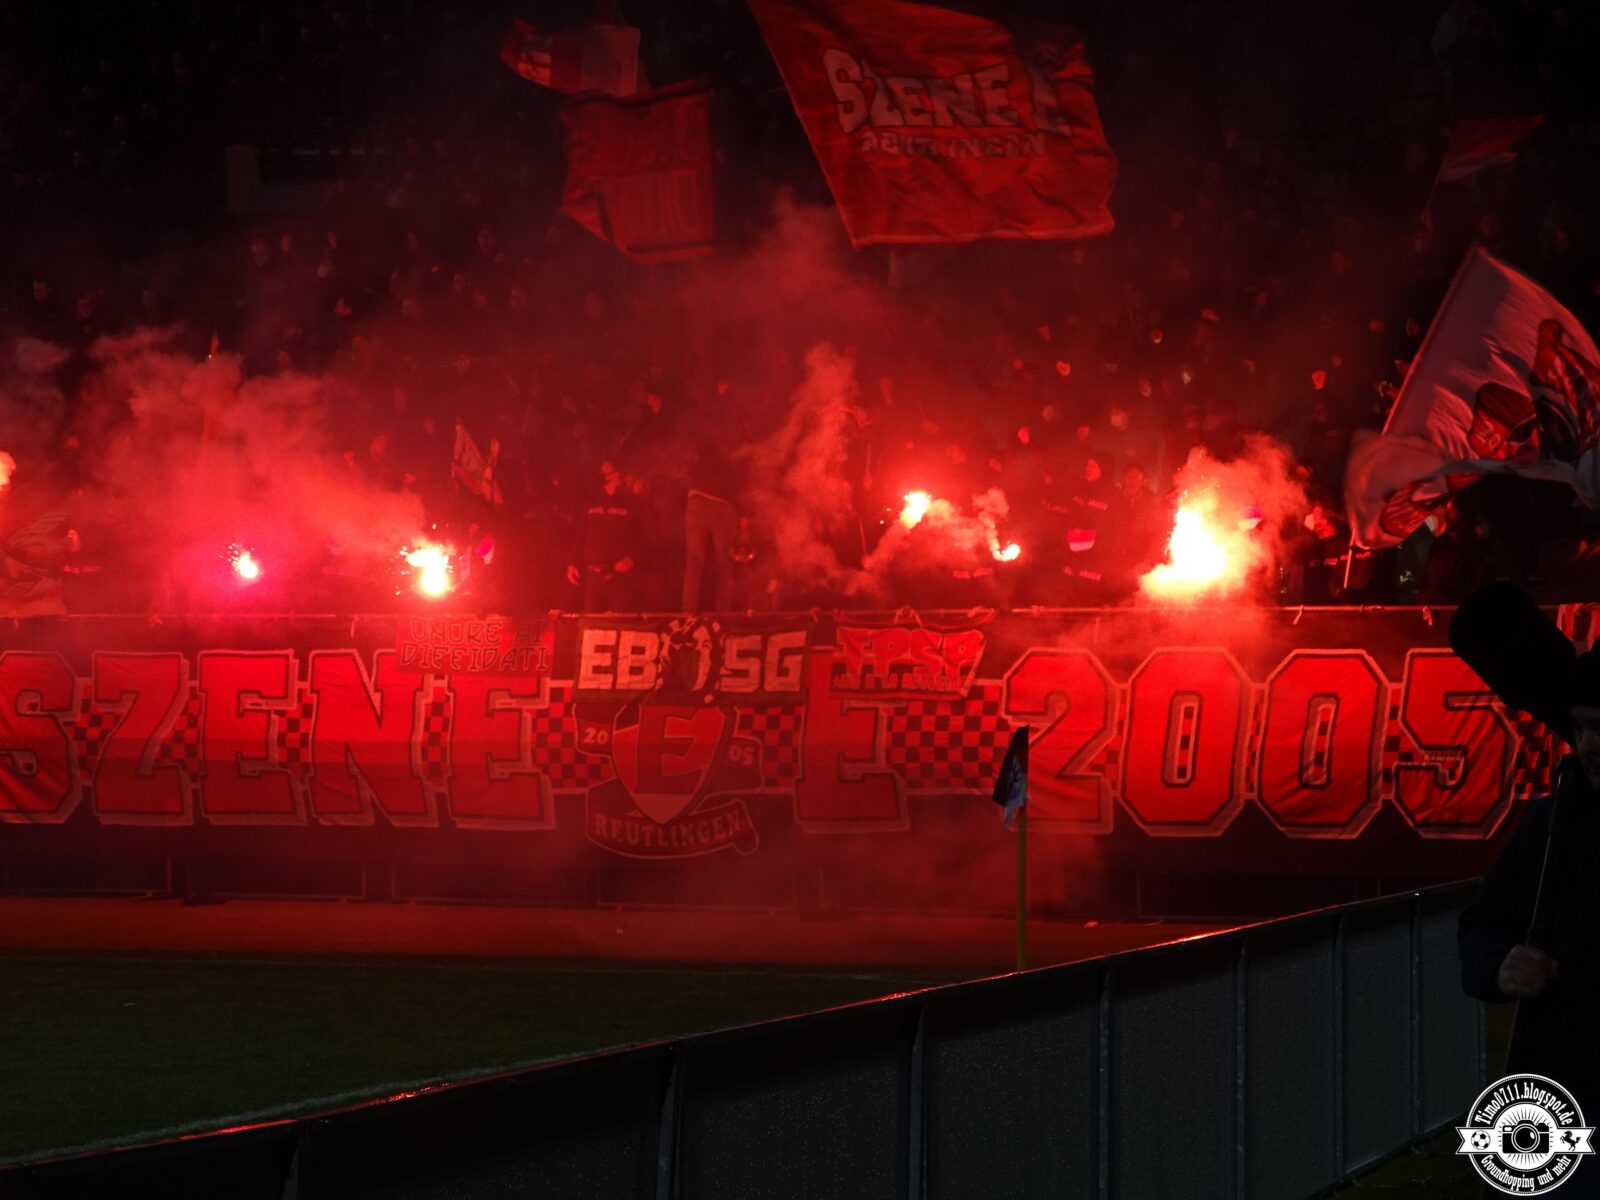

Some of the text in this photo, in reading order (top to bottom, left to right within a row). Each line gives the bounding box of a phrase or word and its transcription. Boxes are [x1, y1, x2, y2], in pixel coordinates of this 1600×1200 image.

[400, 641, 550, 672] DIFFIDATI
[0, 646, 1519, 840] SZENE E 2005
[584, 727, 609, 745] 20
[729, 745, 755, 766] 05
[594, 810, 743, 848] REUTLINGEN
